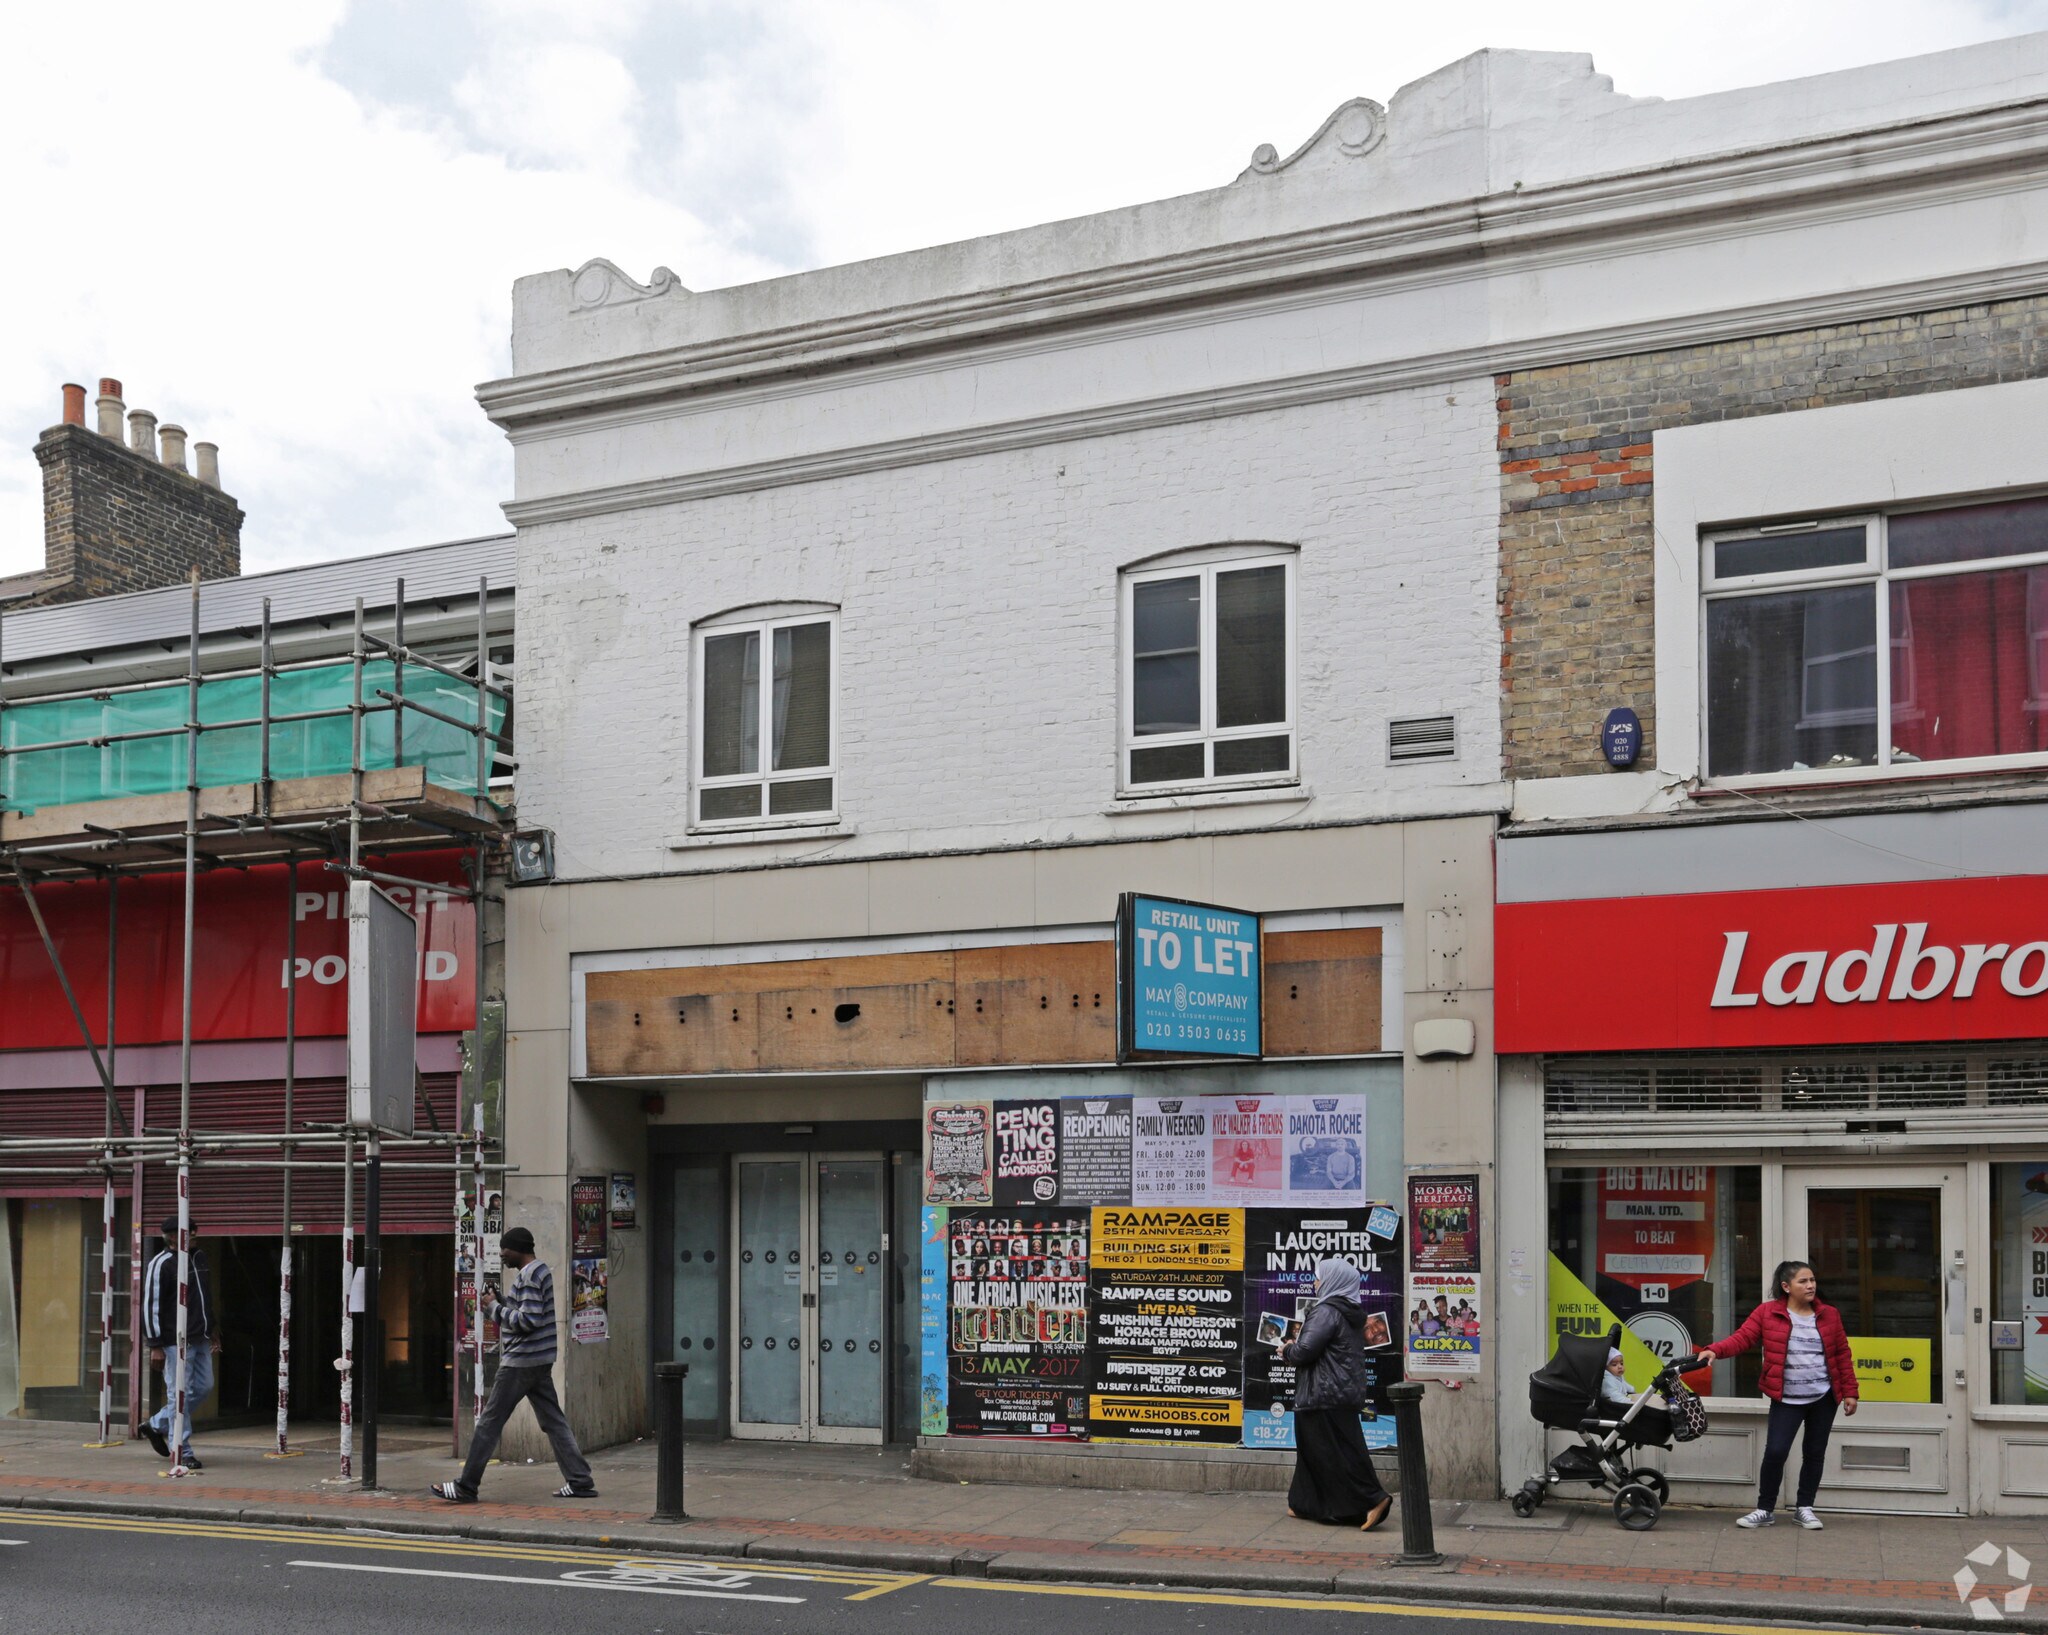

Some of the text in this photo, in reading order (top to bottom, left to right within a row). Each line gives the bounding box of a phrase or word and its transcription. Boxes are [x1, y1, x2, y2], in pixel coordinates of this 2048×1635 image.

[295, 881, 449, 921] PICH
[1152, 909, 1240, 936] RETAIL UNIT
[1138, 928, 1254, 978] TO LET
[281, 951, 458, 988] POD
[1710, 922, 2048, 1008] Ladbro
[1146, 987, 1248, 1010] MAY COMPANY
[1179, 1012, 1206, 1020] LEISURE
[1209, 1015, 1247, 1023] SPECIALISTS
[1147, 1023, 1247, 1042] 020 3503 0635
[996, 1106, 1055, 1129] PENG
[1064, 1115, 1130, 1137] REOPENING
[1136, 1115, 1205, 1136] FAMILY WEEKEND
[1212, 1114, 1283, 1135] KYLE WALKER & FRIENDS
[1290, 1114, 1362, 1135] DAKOTA ROCHE
[997, 1127, 1055, 1152] TING
[999, 1149, 1056, 1166] CALLED
[1136, 1150, 1206, 1159] FRI. 16:00 22:00
[1155, 1170, 1175, 1178] 10:00
[1185, 1170, 1206, 1178] 20:00
[1606, 1166, 1707, 1191] BIG MATCH
[1136, 1182, 1206, 1191] SUN. 12:00 18:00
[1414, 1186, 1473, 1195] MORGAN
[1414, 1195, 1473, 1204] HERITAGE
[1626, 1205, 1683, 1216] MAN. UTD.
[1103, 1212, 1230, 1227] RAMPAGE
[1383, 1212, 1397, 1223] MAY
[1370, 1217, 1395, 1233] 2017
[1139, 1228, 1230, 1236] ANNIVERSARY
[1635, 1230, 1675, 1244] TO BEAT
[1275, 1232, 1372, 1251] LAUGHTER
[1103, 1243, 1191, 1254] BUILDING SIX
[1147, 1256, 1186, 1264] LONDON
[1266, 1252, 1382, 1272] IN MY OUL
[1611, 1255, 1692, 1271] CELTA VIGO
[1111, 1273, 1224, 1283] SATURDAY 24TH JUNE 2017
[1278, 1273, 1296, 1282] LIVE
[1413, 1276, 1476, 1285] SHEBADA
[953, 1281, 1087, 1308] ONE AFRICA MUSIC FEST
[1102, 1287, 1232, 1302] RAMPAGE SOUND
[1436, 1286, 1476, 1294] 10 YEARS
[1644, 1287, 1666, 1299] 1-0
[1138, 1304, 1197, 1316] LIVE PA'S
[1557, 1303, 1599, 1313] WHEN THE
[1099, 1314, 1236, 1329] SUNSHINE ANDERSON
[1556, 1317, 1601, 1335] FUN
[1115, 1326, 1220, 1340] HORACE BROWN
[980, 1342, 1030, 1353] shutdown
[1098, 1337, 1129, 1345] ROMEO
[1138, 1338, 1156, 1346] LISA
[1157, 1339, 1190, 1347] MAFFIA
[1191, 1340, 1207, 1348] (SO
[1208, 1341, 1237, 1349] SOLID)
[1413, 1337, 1473, 1351] CHIXTA
[1153, 1347, 1181, 1355] EGYPT
[1038, 1358, 1080, 1376] 2017
[1857, 1359, 1882, 1369] FUN
[1188, 1366, 1197, 1377] &
[1200, 1366, 1227, 1378] CKP
[1150, 1376, 1182, 1385] MC DET
[975, 1390, 1063, 1400] GET YOUR TICKETS AT
[1097, 1383, 1109, 1391] DJ
[1109, 1383, 1132, 1391] SUEY
[1140, 1384, 1161, 1392] FULL
[1163, 1385, 1194, 1394] ONTOP
[1195, 1386, 1208, 1394] FM
[1209, 1386, 1237, 1395] CREW
[980, 1411, 1056, 1423] WWW.COKOBAR.COM
[1102, 1408, 1230, 1423] WWW.SHOOBS.COM
[1260, 1416, 1282, 1426] Tickets
[1253, 1427, 1289, 1439] £18-27
